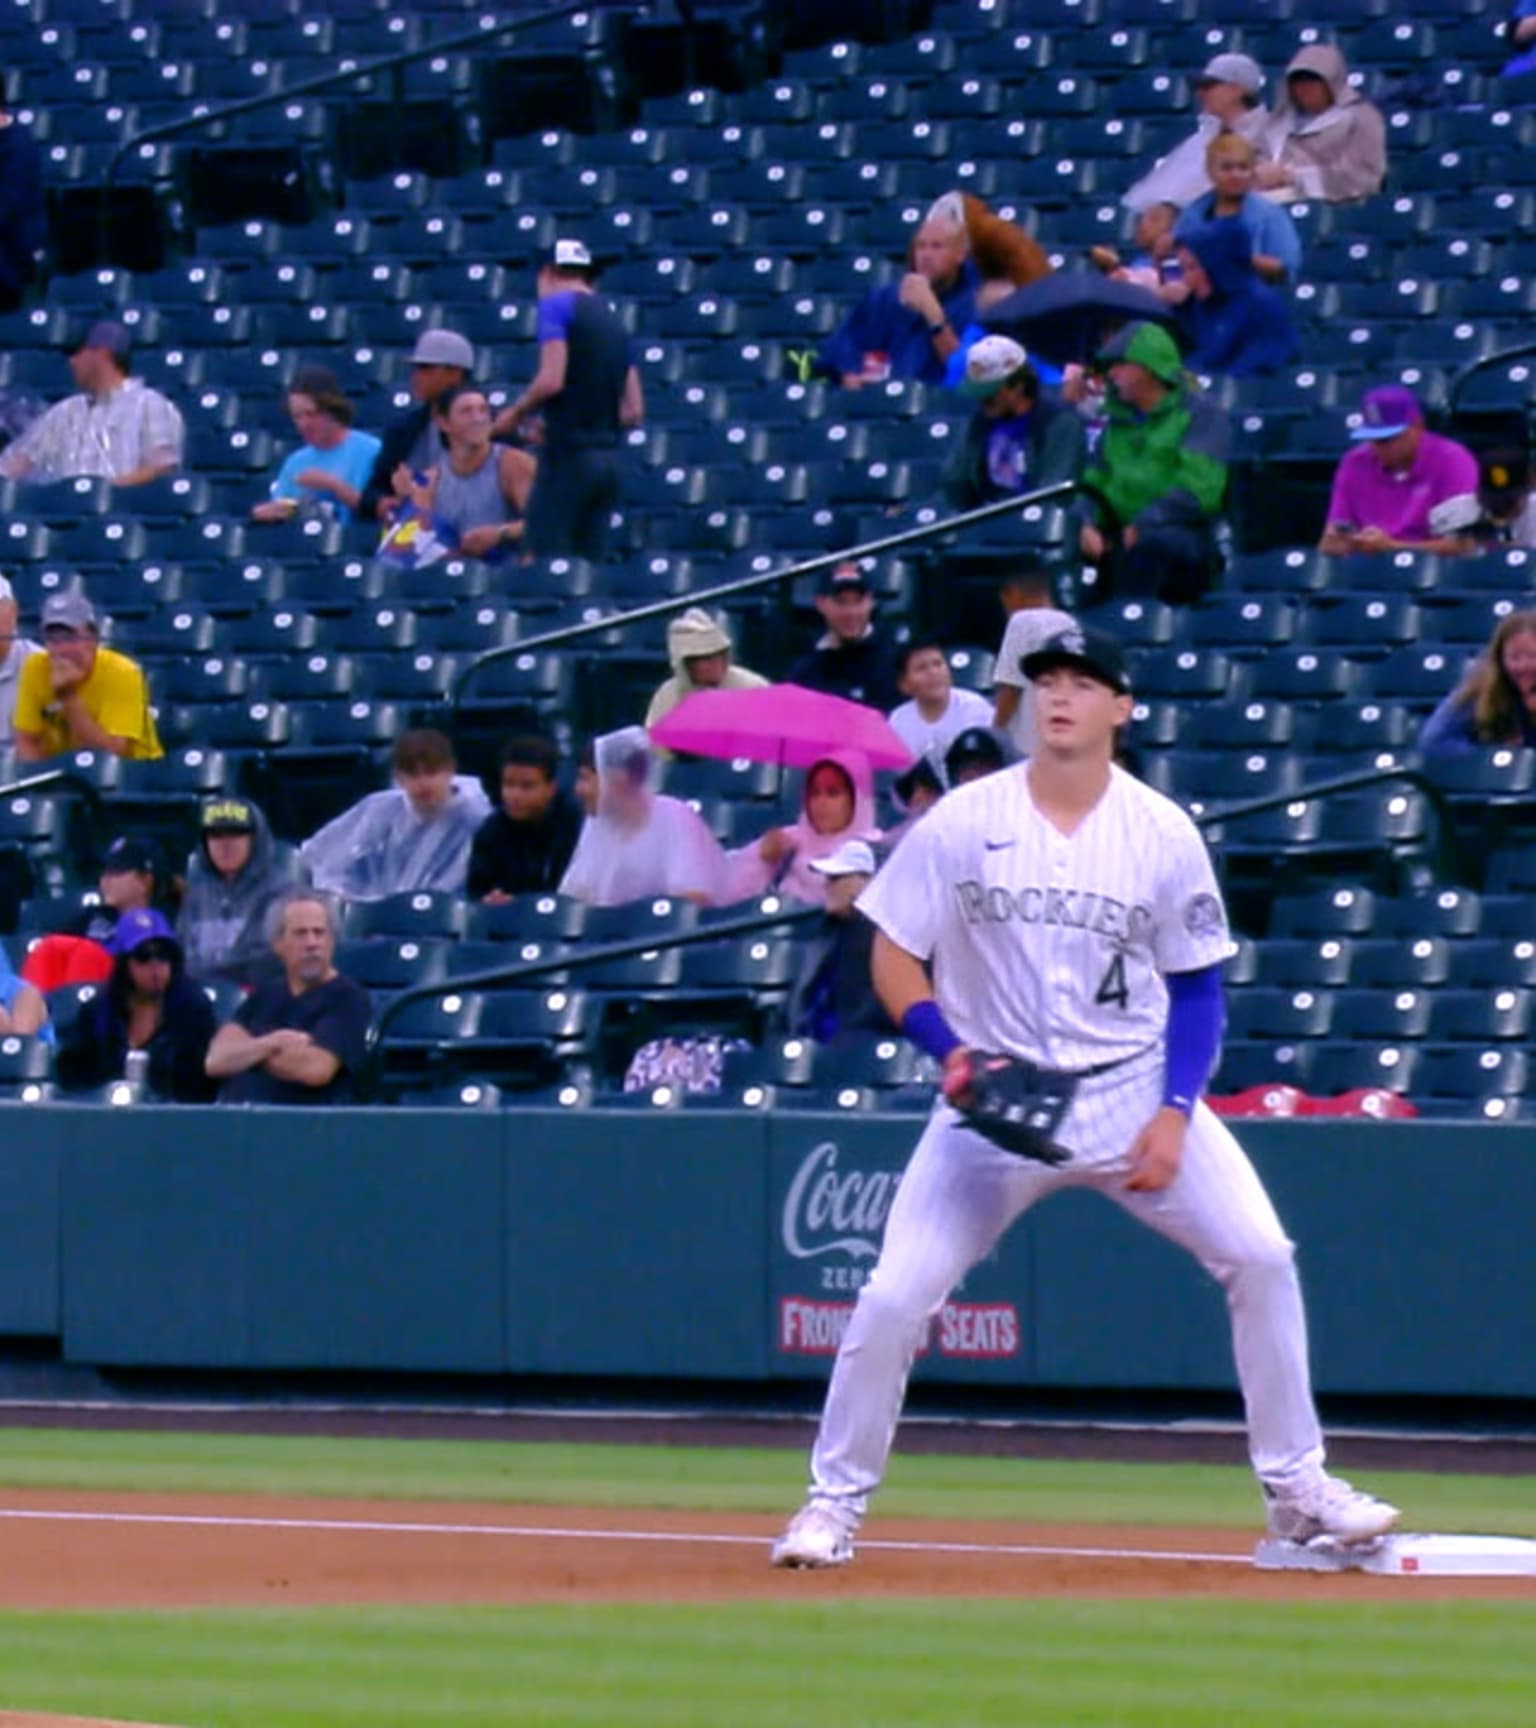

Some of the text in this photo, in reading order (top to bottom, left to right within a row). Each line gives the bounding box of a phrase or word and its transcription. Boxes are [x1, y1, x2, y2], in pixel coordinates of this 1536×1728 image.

[955, 880, 1157, 946] ROCKIES
[1094, 953, 1129, 1009] 4
[941, 1305, 1016, 1351] SEATS
